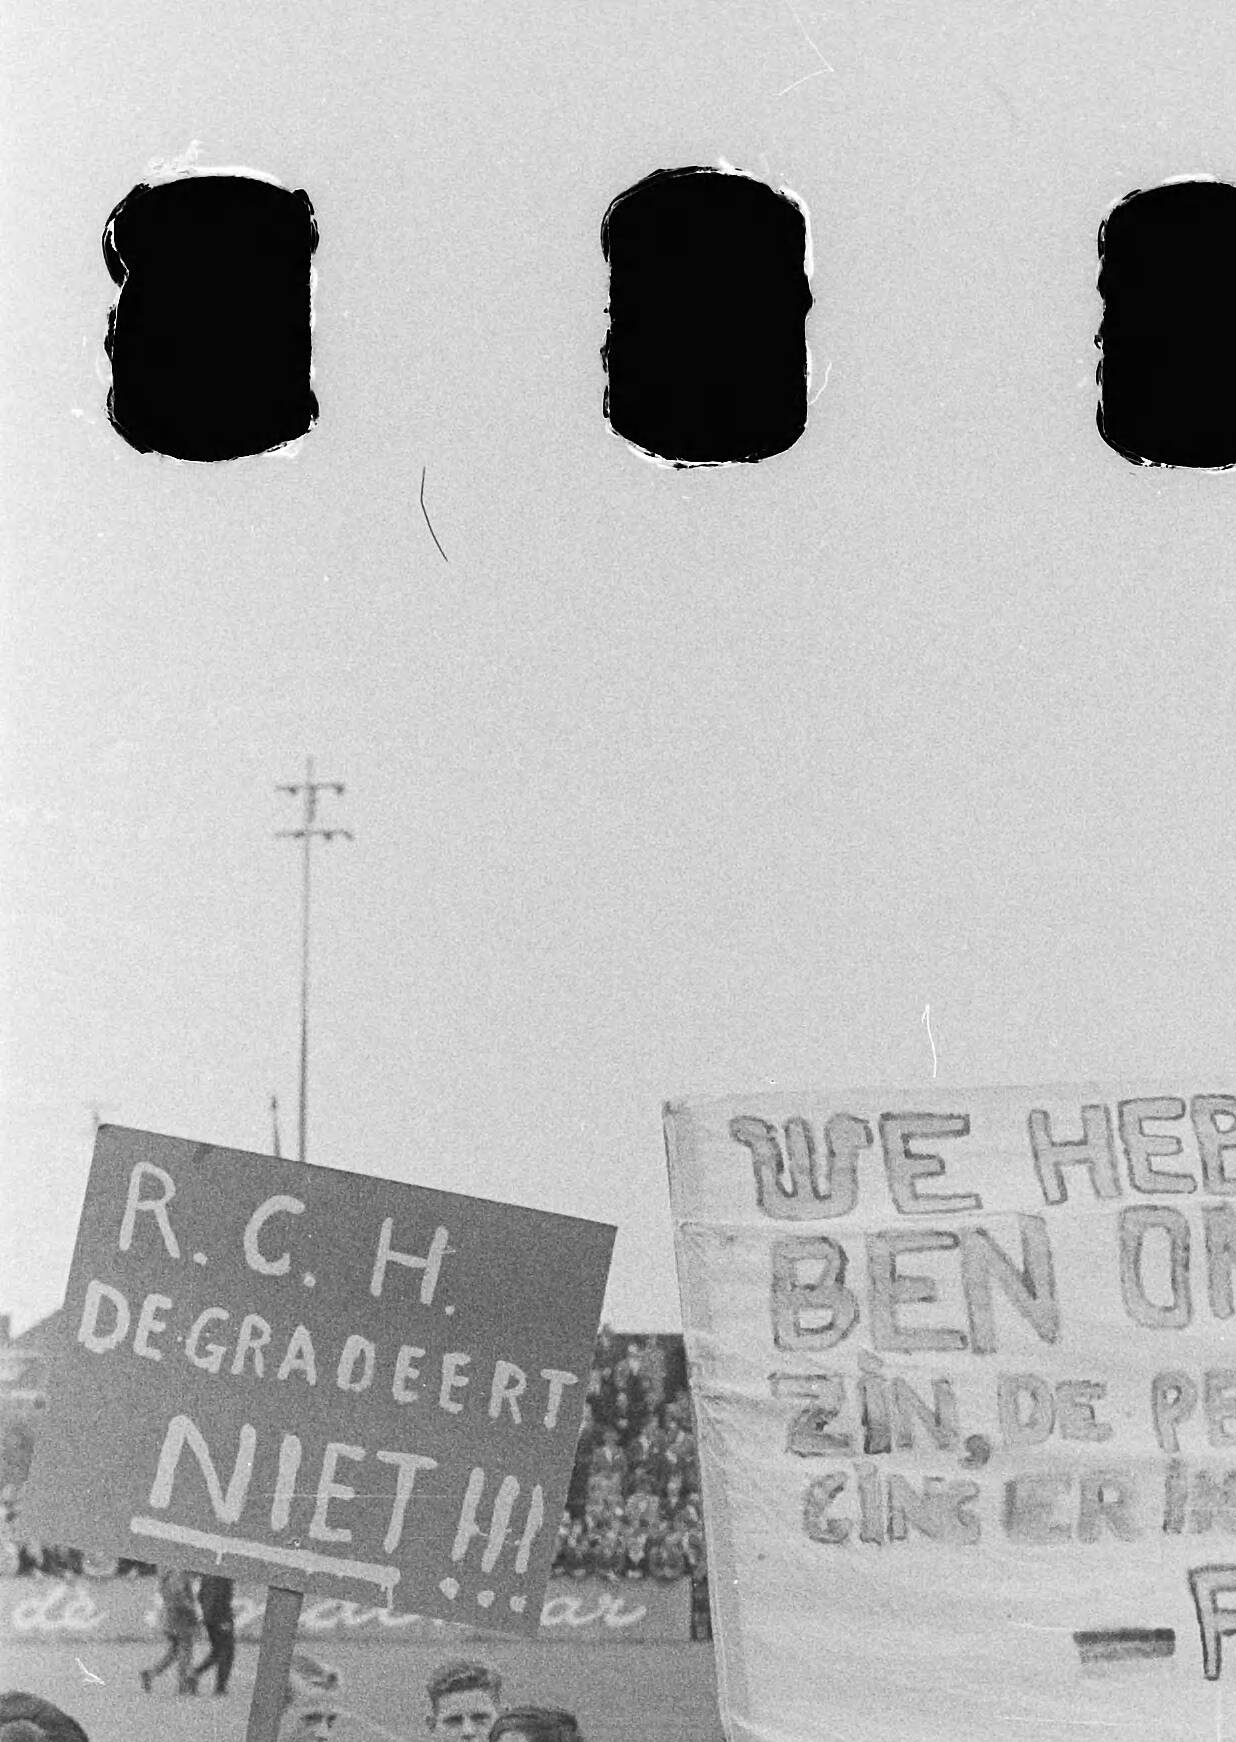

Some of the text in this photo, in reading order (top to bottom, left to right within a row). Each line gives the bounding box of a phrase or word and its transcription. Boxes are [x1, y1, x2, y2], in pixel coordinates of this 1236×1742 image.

[729, 1112, 983, 1221] WE
[771, 1212, 1060, 1354] BEN
[78, 1280, 579, 1429] DEGRADEERT
[998, 1373, 1113, 1446] DE
[1003, 1470, 1144, 1545] ER
